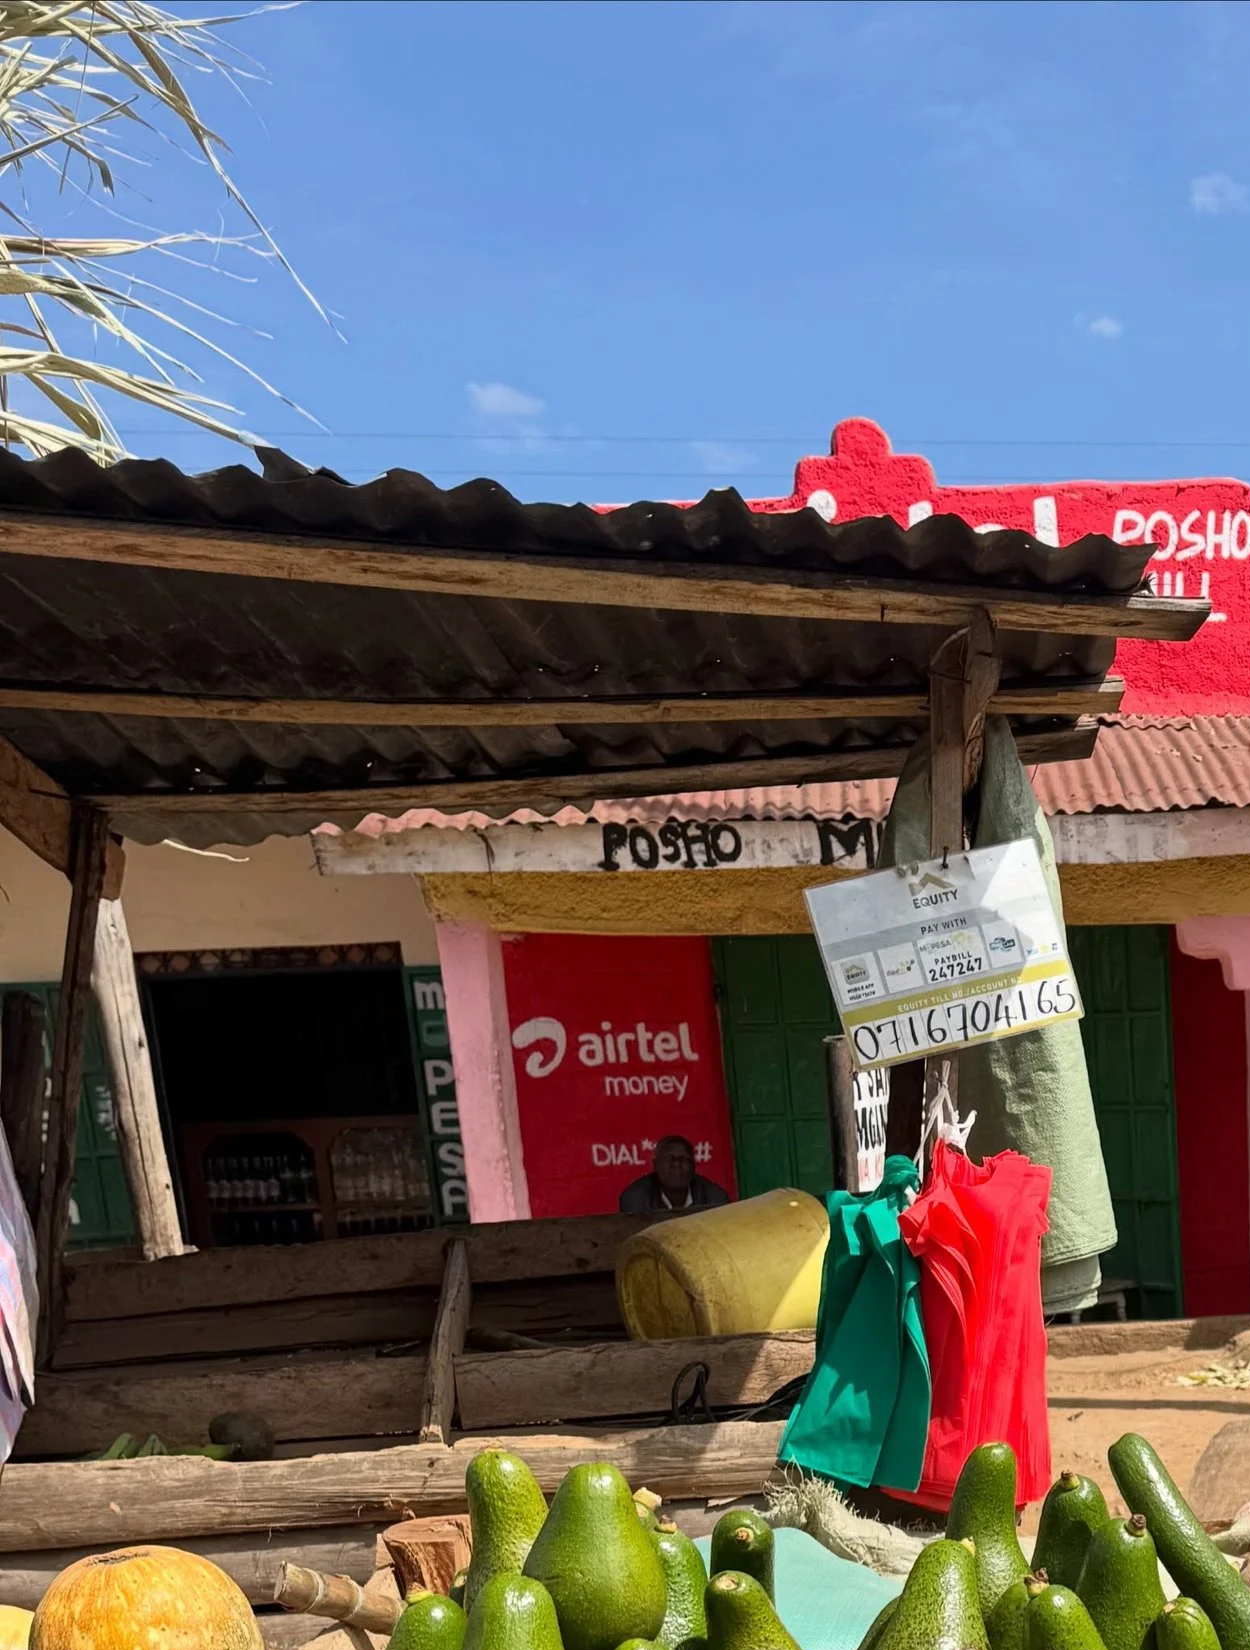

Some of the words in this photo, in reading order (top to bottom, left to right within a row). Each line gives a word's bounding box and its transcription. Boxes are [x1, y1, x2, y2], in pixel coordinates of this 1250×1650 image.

[1149, 571, 1228, 622] ILL
[598, 822, 742, 870] POSHO
[820, 820, 886, 869] MI
[912, 888, 959, 909] EQUITY
[921, 923, 939, 935] PAY
[942, 917, 967, 931] WITH
[929, 957, 983, 982] 247247
[934, 950, 973, 966] PAYBILL
[898, 998, 928, 1013] EQUITY
[931, 992, 950, 1006] TILL
[853, 979, 1077, 1061] 0716704165
[577, 1021, 699, 1067] airtel
[604, 1075, 689, 1102] money
